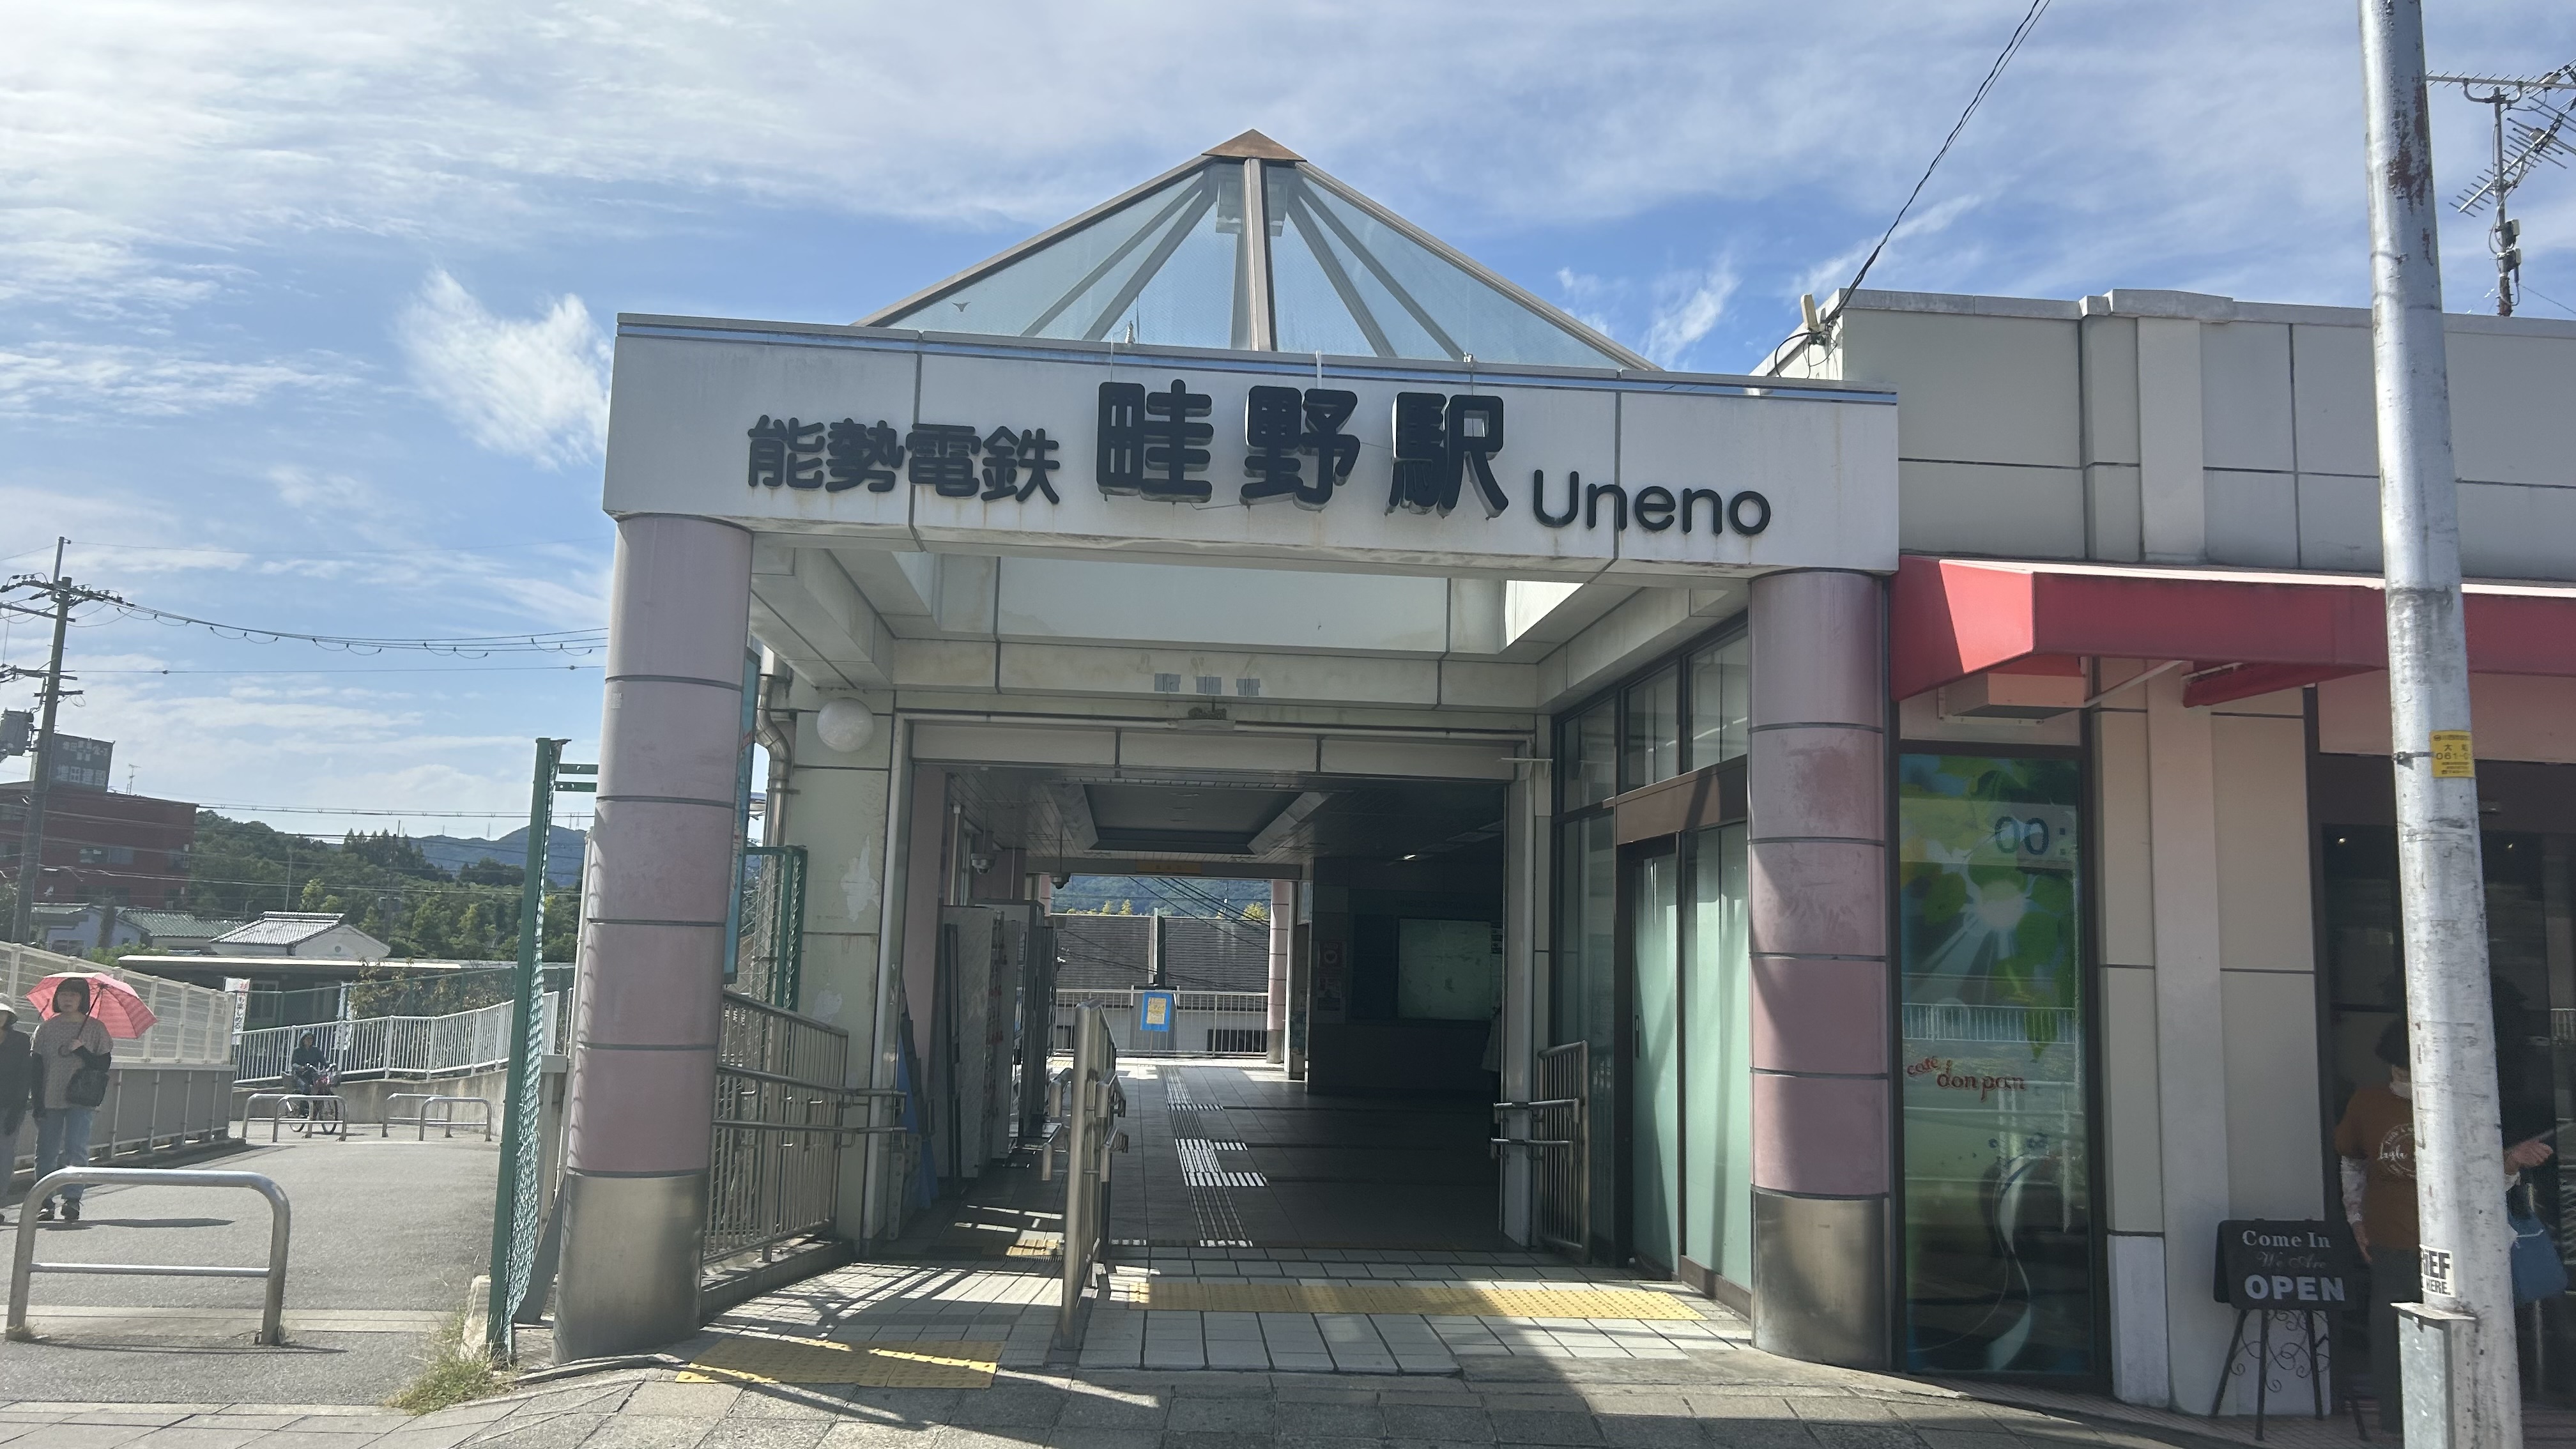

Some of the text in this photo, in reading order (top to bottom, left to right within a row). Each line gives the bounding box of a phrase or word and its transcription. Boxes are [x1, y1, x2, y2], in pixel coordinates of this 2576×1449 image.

[748, 379, 1772, 535] 能勢電鉄 畦野駅 Uneno
[2242, 1230, 2331, 1248] Come In
[2244, 1274, 2345, 1301] OPEN
